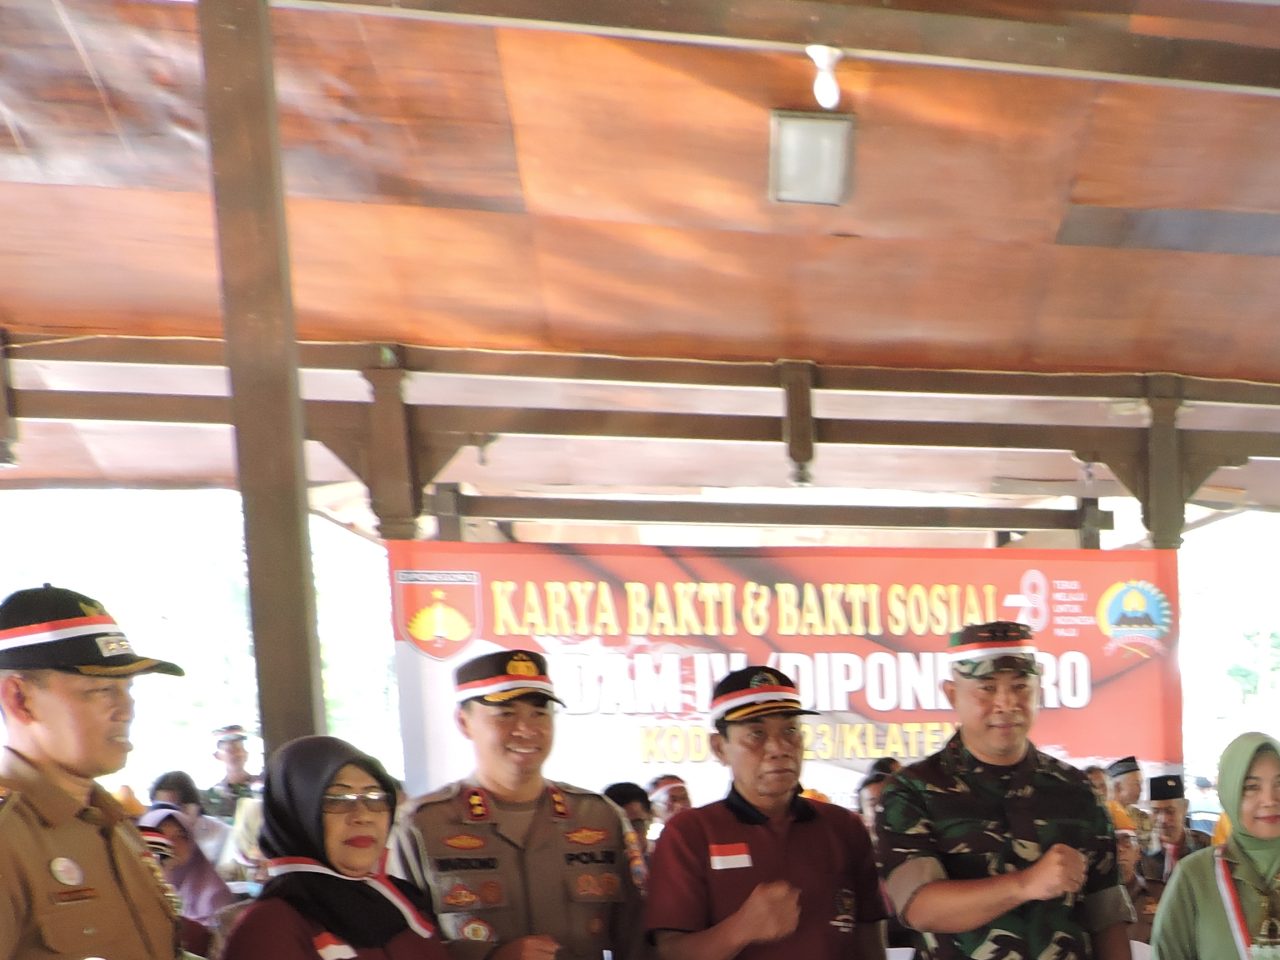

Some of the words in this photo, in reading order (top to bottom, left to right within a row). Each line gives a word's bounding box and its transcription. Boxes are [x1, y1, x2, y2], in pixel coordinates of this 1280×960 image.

[490, 580, 621, 637] KARYA
[625, 581, 736, 636] BAKTI
[743, 581, 770, 635] &
[775, 582, 881, 636] BAKTI
[555, 651, 682, 714] DAM
[641, 726, 708, 763] KOD
